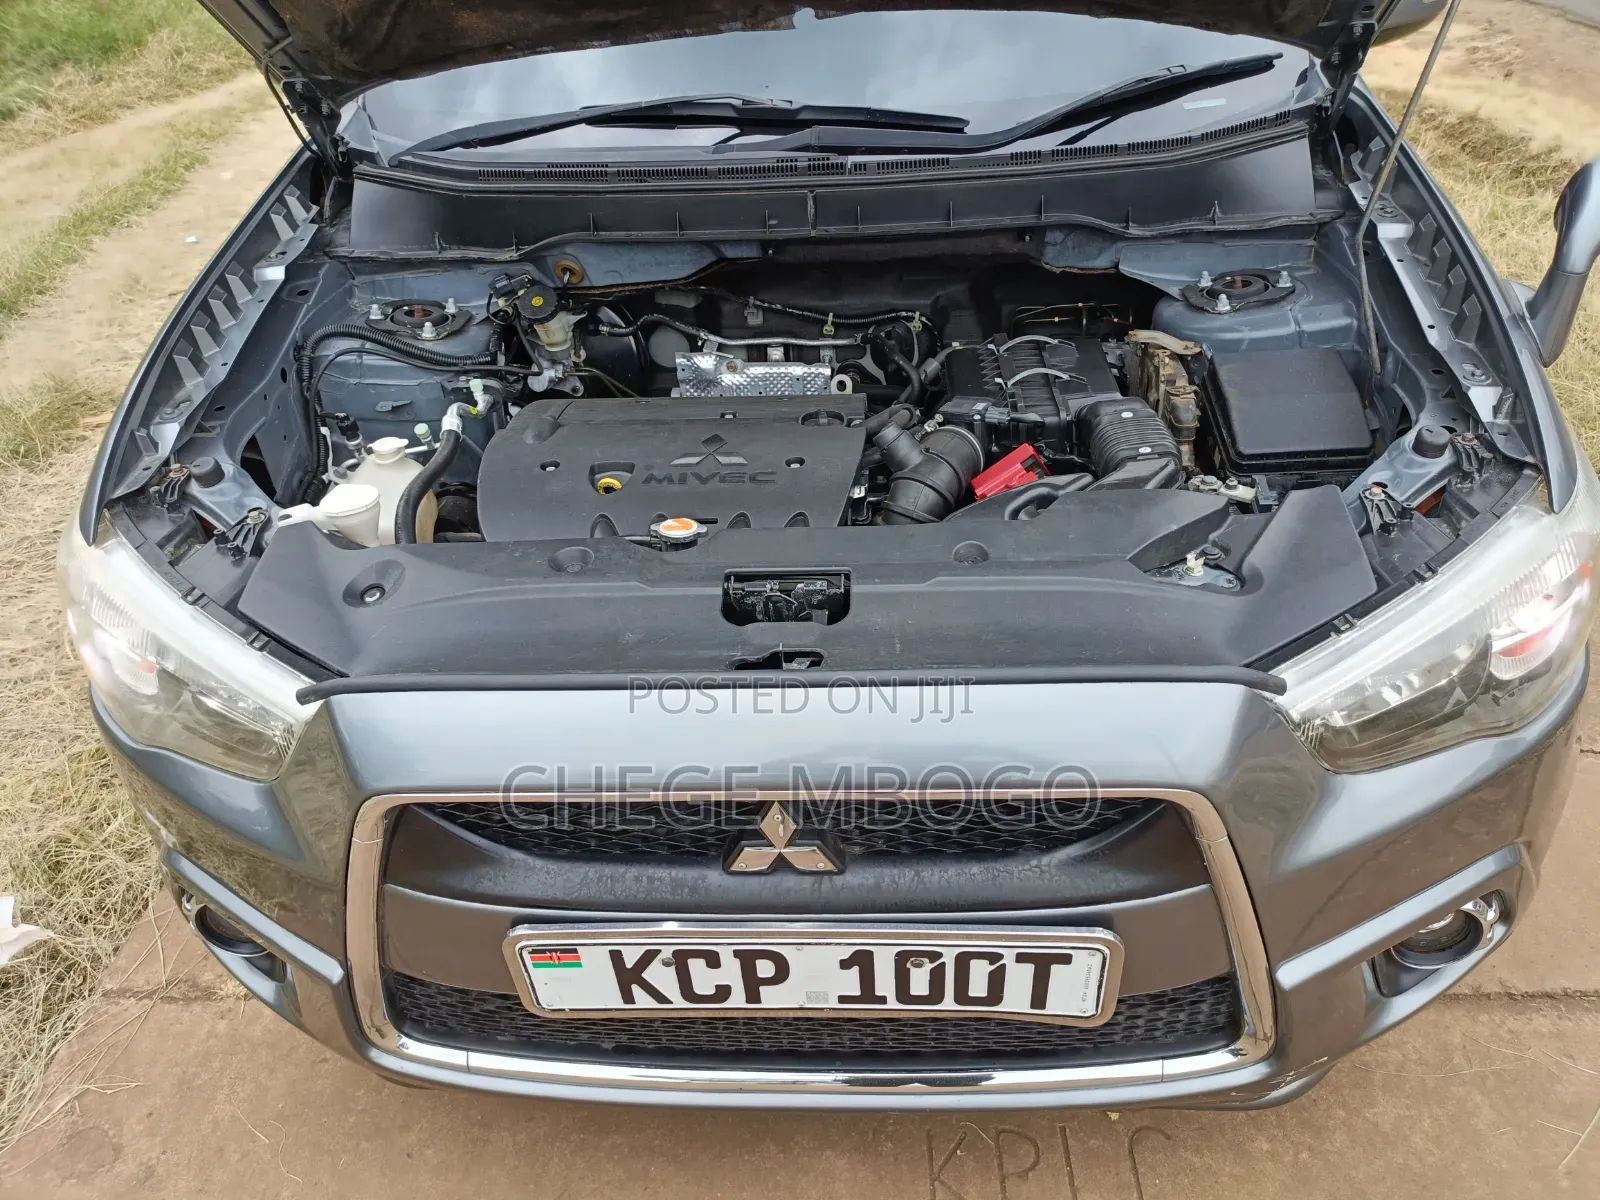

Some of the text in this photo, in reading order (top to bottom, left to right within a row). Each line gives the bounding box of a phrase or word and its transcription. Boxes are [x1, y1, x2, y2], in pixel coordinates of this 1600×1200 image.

[641, 471, 777, 485] MIVEC
[608, 948, 790, 1005] KCP
[837, 948, 1073, 1010] 100T
